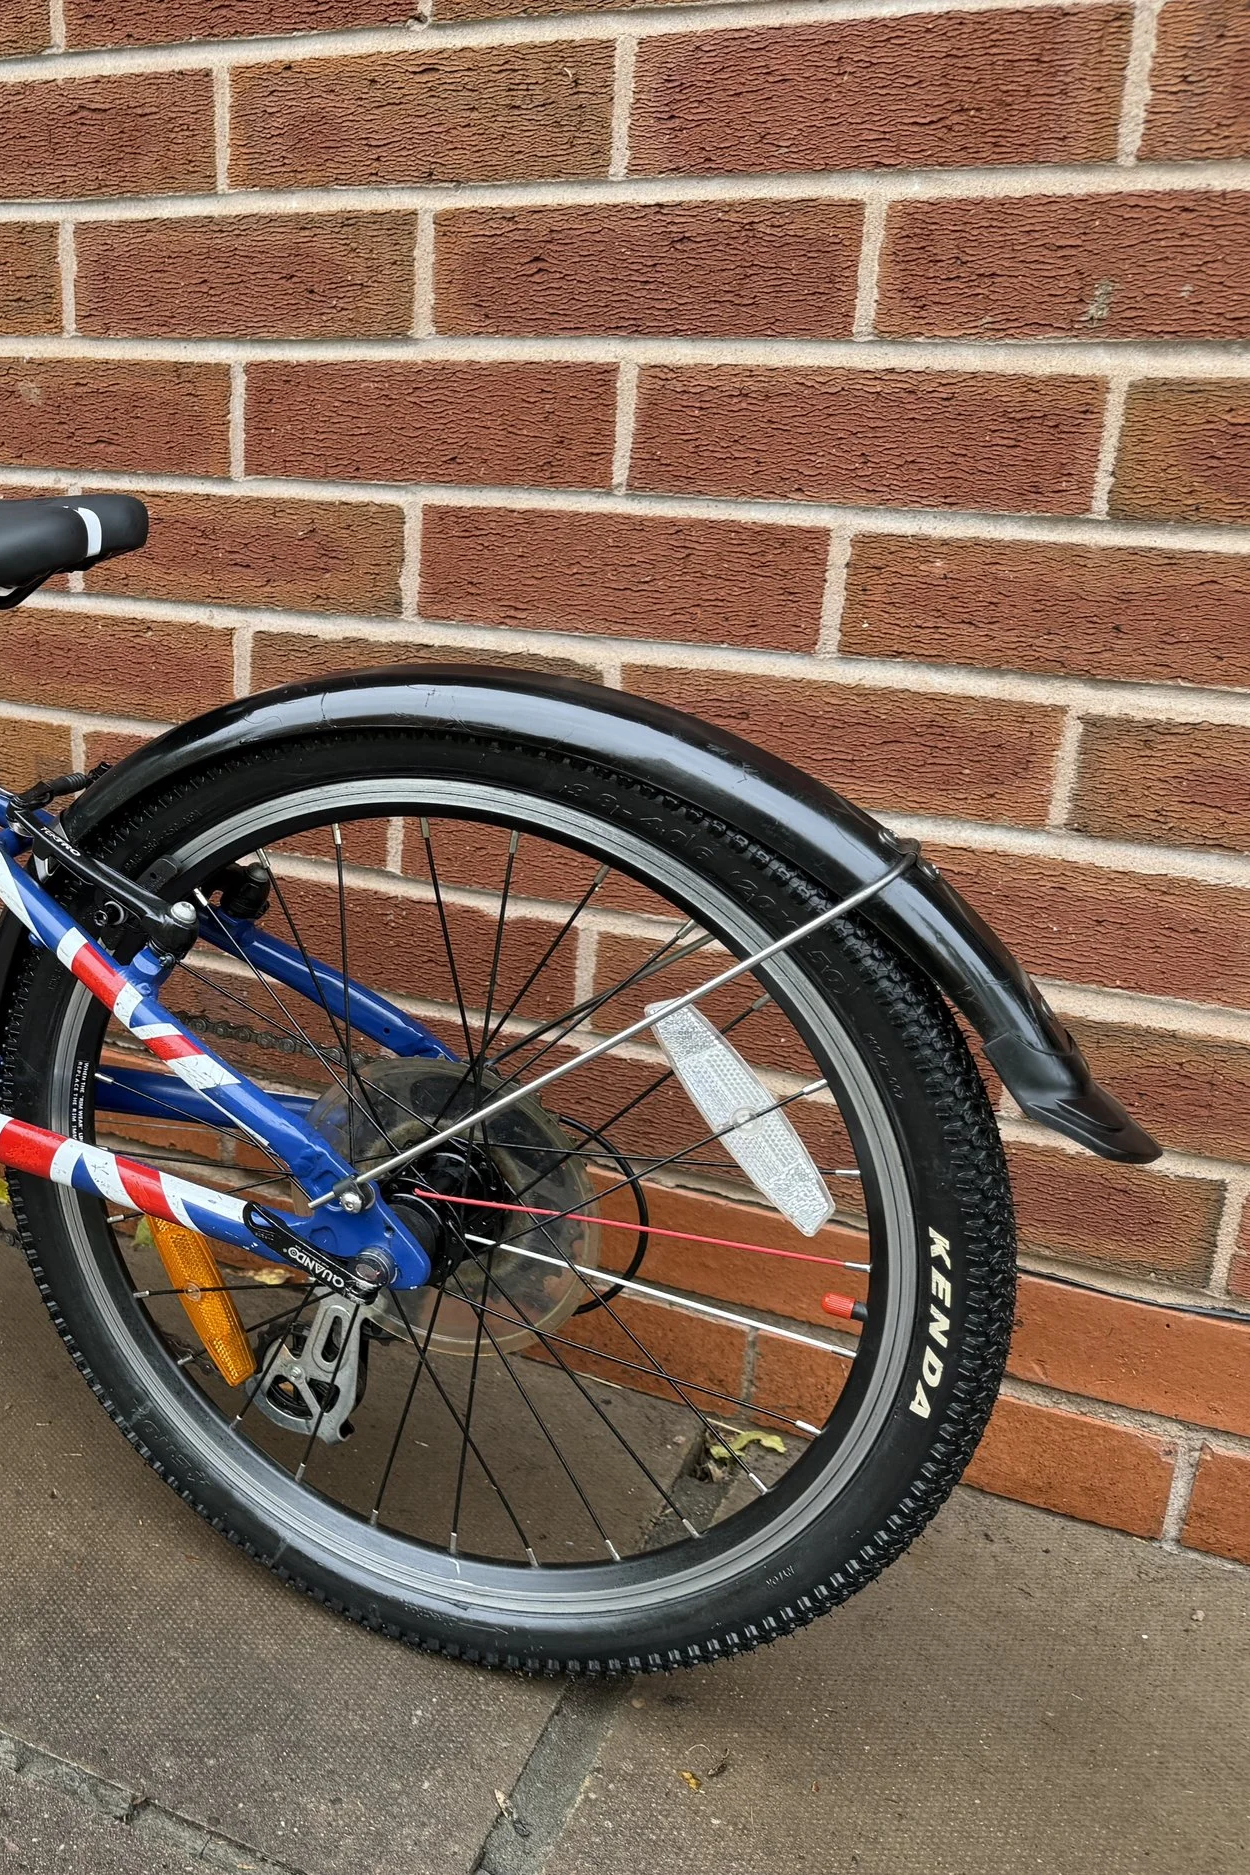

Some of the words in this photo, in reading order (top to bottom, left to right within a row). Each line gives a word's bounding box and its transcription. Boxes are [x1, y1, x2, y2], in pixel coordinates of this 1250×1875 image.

[40, 826, 81, 857] TEKTRO
[74, 1062, 83, 1091] REPLACE
[287, 1246, 345, 1288] QUANDO
[909, 1226, 952, 1419] KENDA
